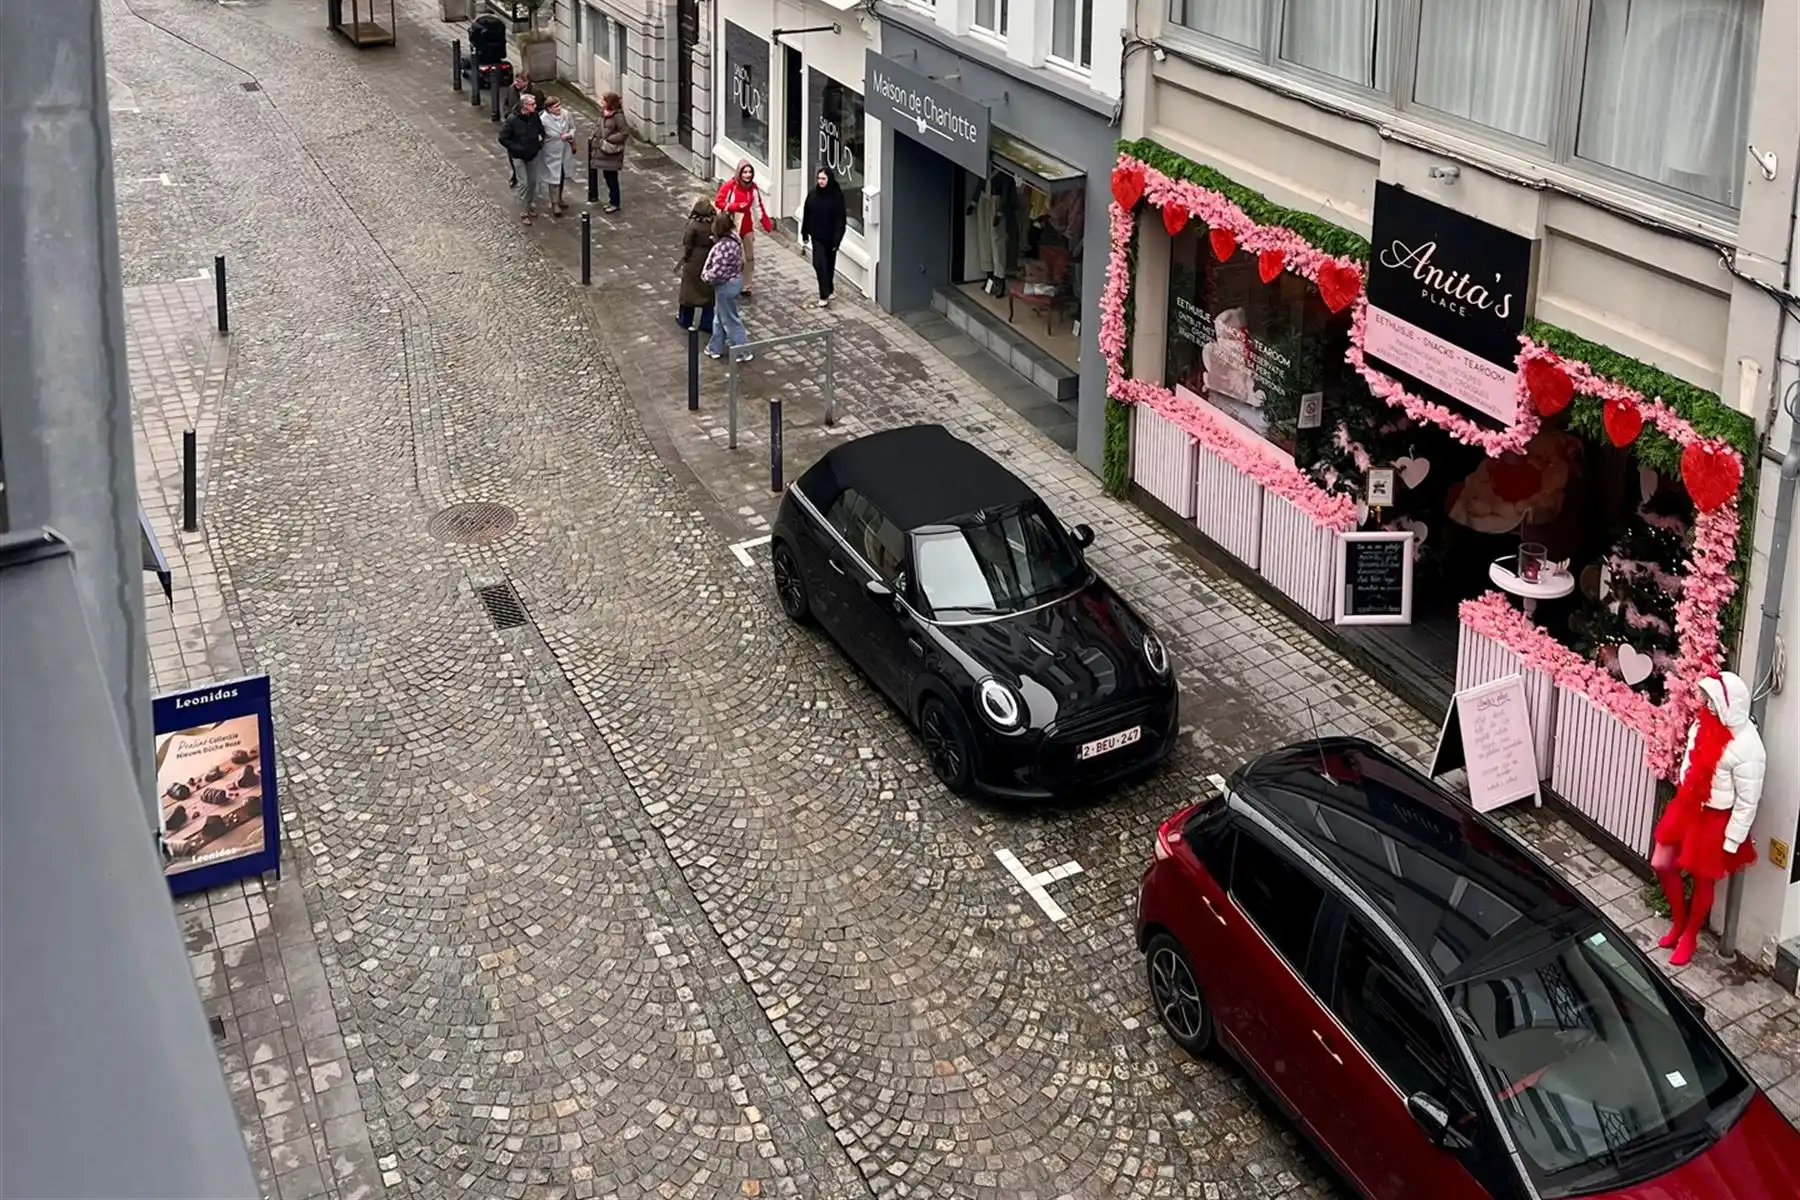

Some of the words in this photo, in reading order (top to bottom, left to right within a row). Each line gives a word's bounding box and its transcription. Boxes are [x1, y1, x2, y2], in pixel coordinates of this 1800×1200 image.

[733, 76, 761, 121] PUUR
[872, 69, 908, 107] Maison
[909, 90, 922, 114] de
[923, 96, 977, 143] Charlotte
[819, 116, 839, 140] SALON
[819, 131, 854, 182] PUUR
[1380, 239, 1512, 319] Anita's
[1421, 288, 1466, 317] PLACE
[1254, 339, 1291, 368] TEAROOM
[1423, 336, 1454, 359] SNACKS
[1464, 357, 1506, 384] TEAROOM
[176, 688, 239, 709] Leonidas
